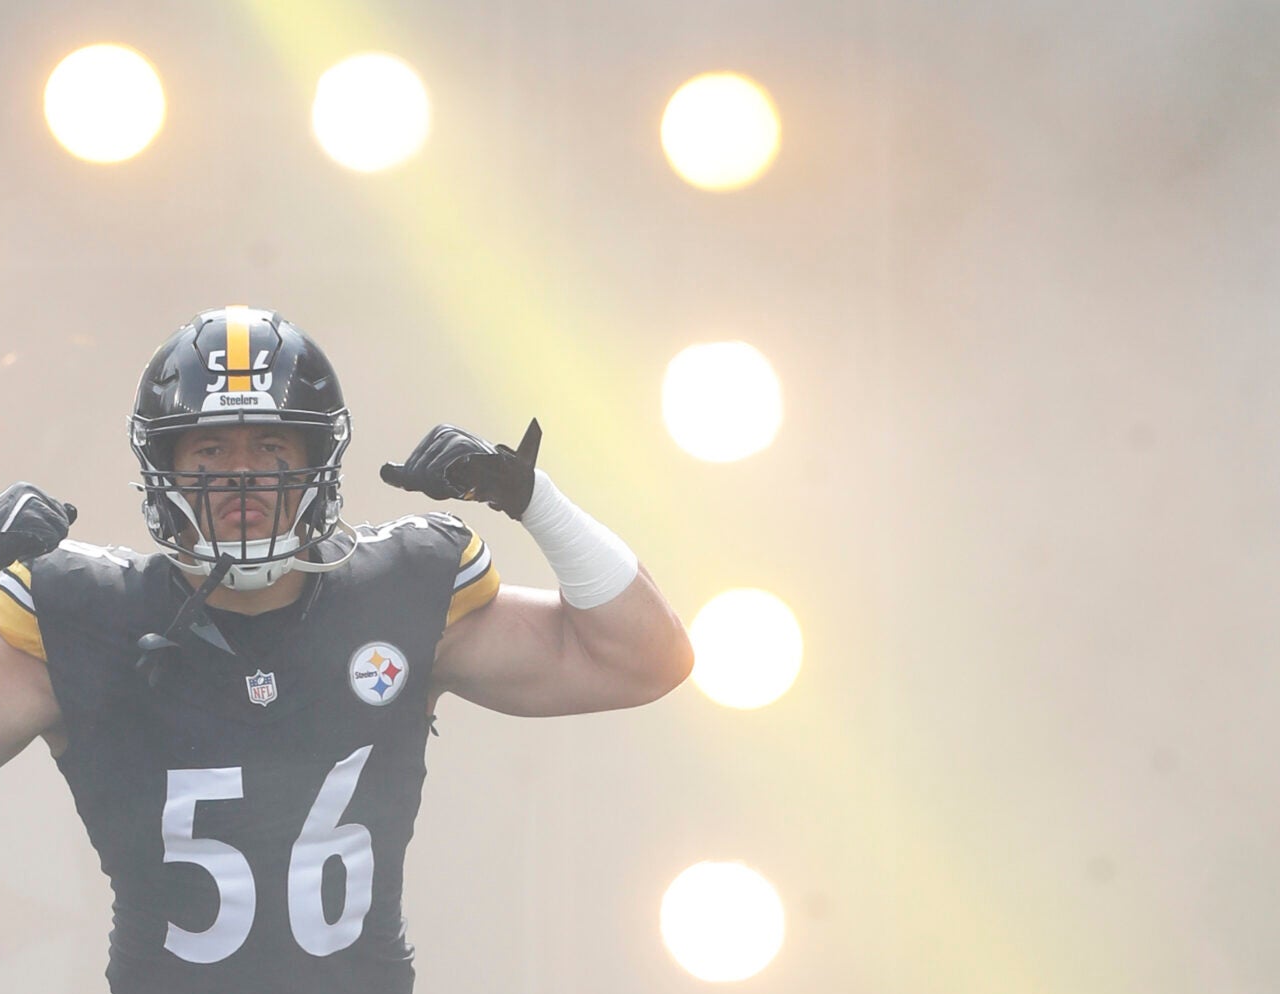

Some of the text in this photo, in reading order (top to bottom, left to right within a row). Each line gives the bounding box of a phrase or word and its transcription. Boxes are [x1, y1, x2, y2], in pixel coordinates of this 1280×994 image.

[206, 350, 273, 392] 56
[219, 394, 259, 406] Steelers
[354, 670, 378, 680] Steelers
[252, 686, 273, 700] NFL
[161, 744, 375, 964] 56
